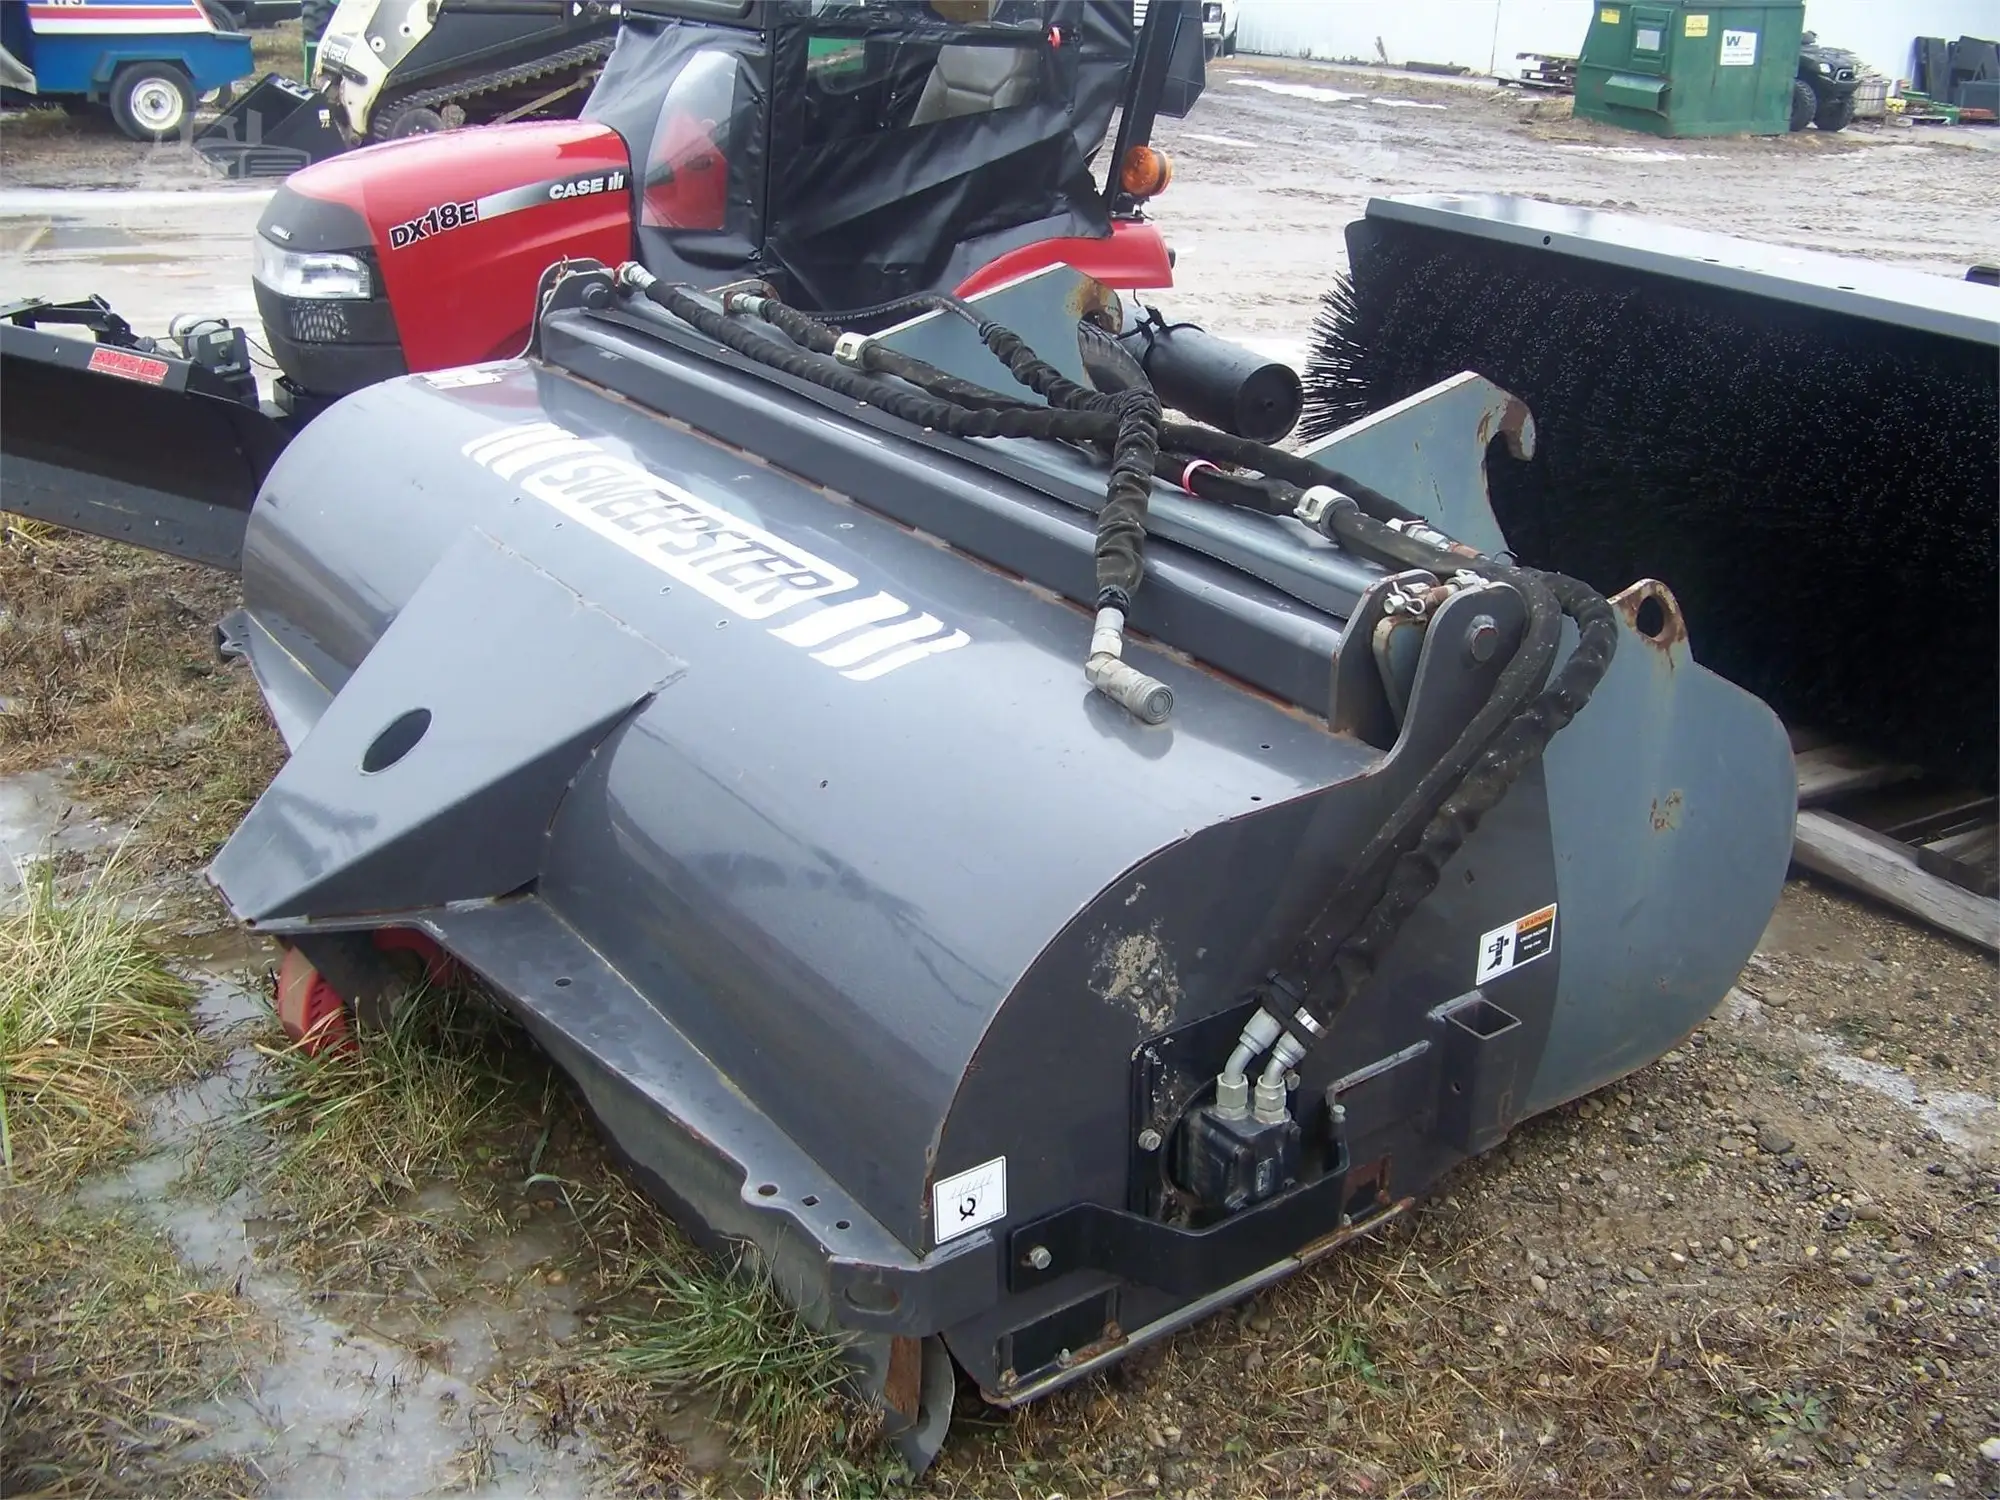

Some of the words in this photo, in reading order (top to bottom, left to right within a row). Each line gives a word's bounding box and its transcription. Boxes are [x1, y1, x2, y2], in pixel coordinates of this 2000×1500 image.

[549, 177, 603, 200] CASE
[389, 200, 478, 250] DX18E
[538, 464, 834, 605] SWEEPSTER
